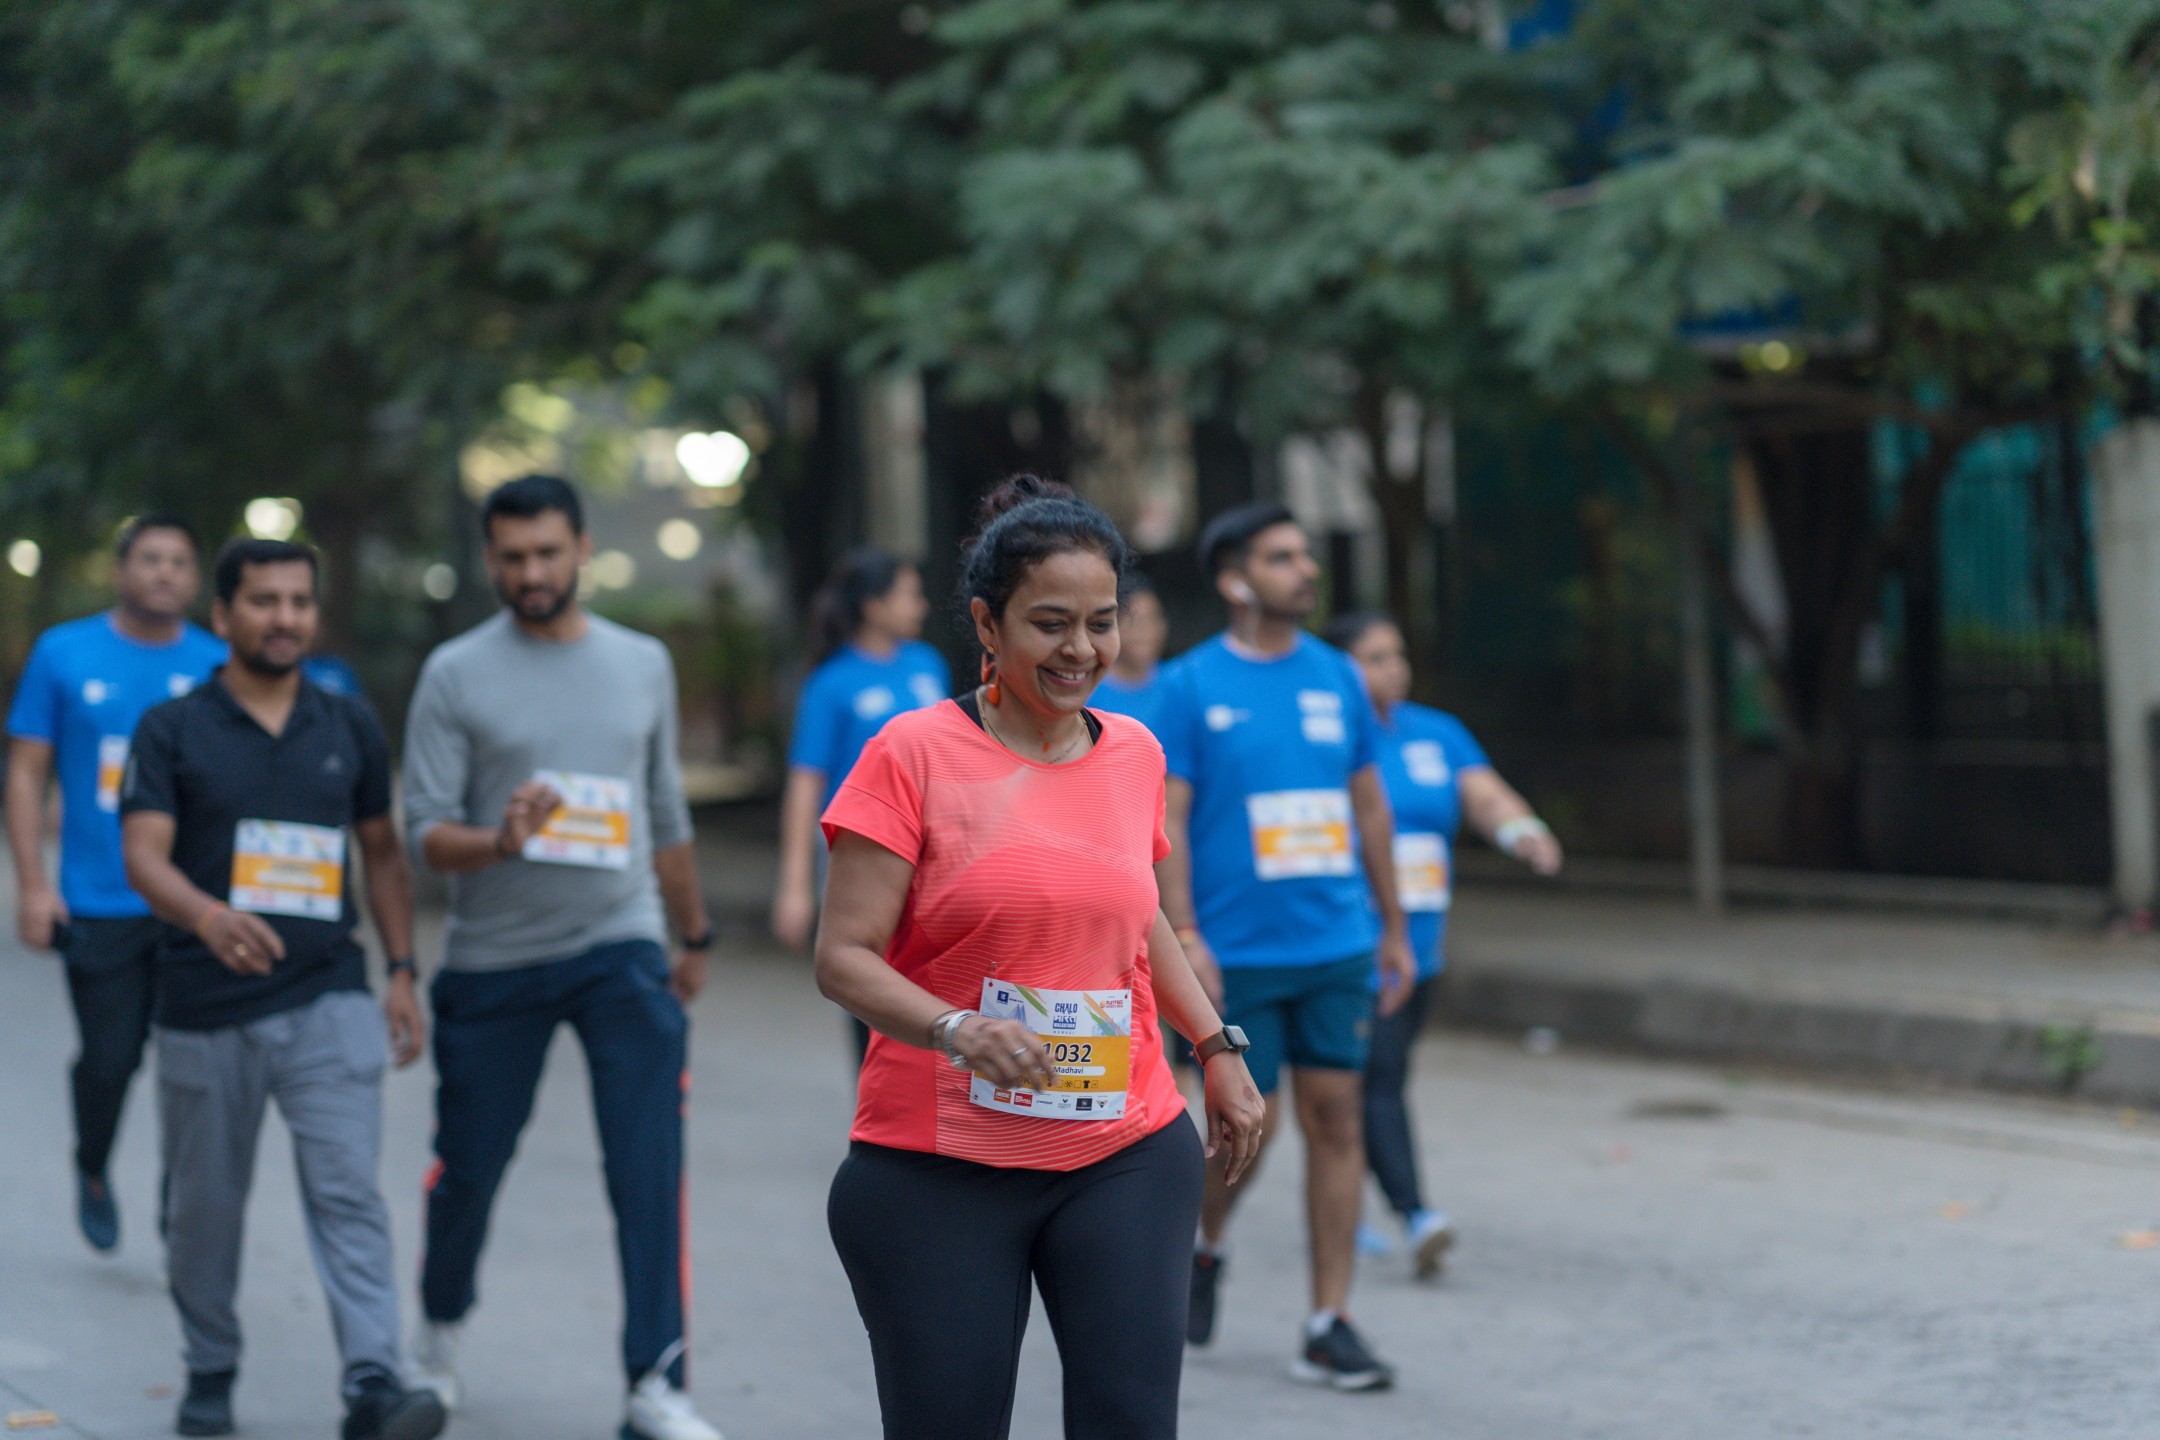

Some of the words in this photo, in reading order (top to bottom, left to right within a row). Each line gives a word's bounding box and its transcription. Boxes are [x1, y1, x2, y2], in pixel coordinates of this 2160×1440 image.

[1054, 1002, 1078, 1014] CHALO
[1043, 1042, 1092, 1063] 1032
[1053, 1066, 1084, 1074] Madhavi
